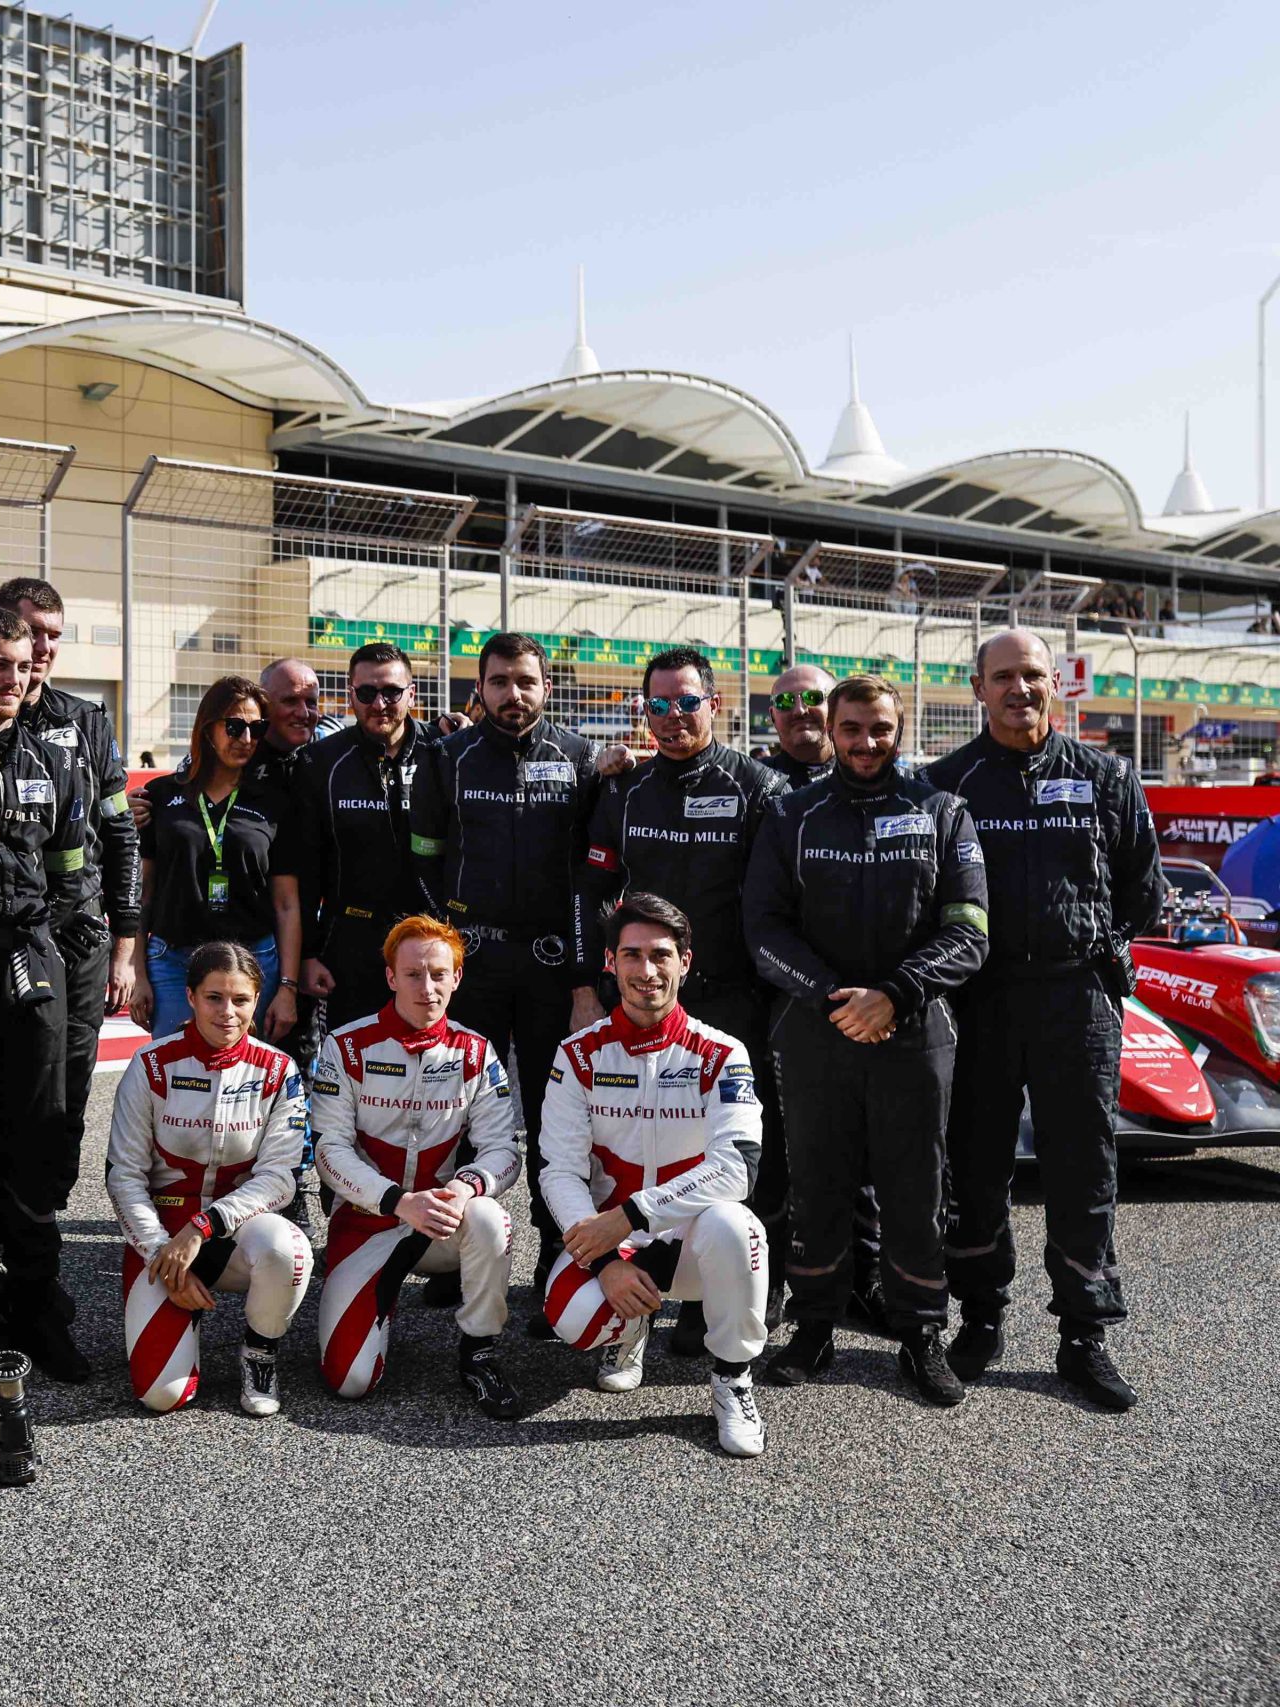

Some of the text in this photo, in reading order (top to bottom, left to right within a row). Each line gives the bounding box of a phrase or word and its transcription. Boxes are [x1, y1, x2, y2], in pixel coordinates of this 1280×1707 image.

[463, 789, 570, 803] RICHARD MILLE
[1041, 783, 1087, 795] WEC
[688, 797, 736, 809] WEC
[976, 816, 1091, 832] ICHARD MILLE
[1178, 819, 1204, 831] FEAR
[628, 826, 738, 844] RICHARD MILLE
[1186, 831, 1204, 842] THE
[804, 848, 929, 864] RICHARD MILLE
[574, 894, 584, 963] RICHARD MILLE
[758, 945, 817, 990] RICHARD MILLE
[1135, 964, 1218, 999] GPNFTS
[1181, 994, 1212, 1010] VELAS
[343, 1037, 359, 1067] Sabelt
[630, 1038, 654, 1051] RICHARD
[571, 1042, 590, 1072] Sabelt
[703, 1046, 723, 1077] Sabelt
[148, 1051, 162, 1083] Sabelt
[367, 1064, 405, 1074] GOODYEAR
[422, 1059, 463, 1075] WEC
[659, 1067, 700, 1080] WEC
[172, 1078, 210, 1090] GOODYEAR
[222, 1079, 264, 1094] WEC
[595, 1076, 637, 1086] GOODYEAR
[359, 1094, 465, 1111] RICHARD MILLE
[588, 1106, 707, 1120] RICHARD MILLE
[161, 1114, 224, 1133] RICHARD
[320, 1151, 342, 1181] RICHARD
[657, 1166, 729, 1207] RICHARD MILLE
